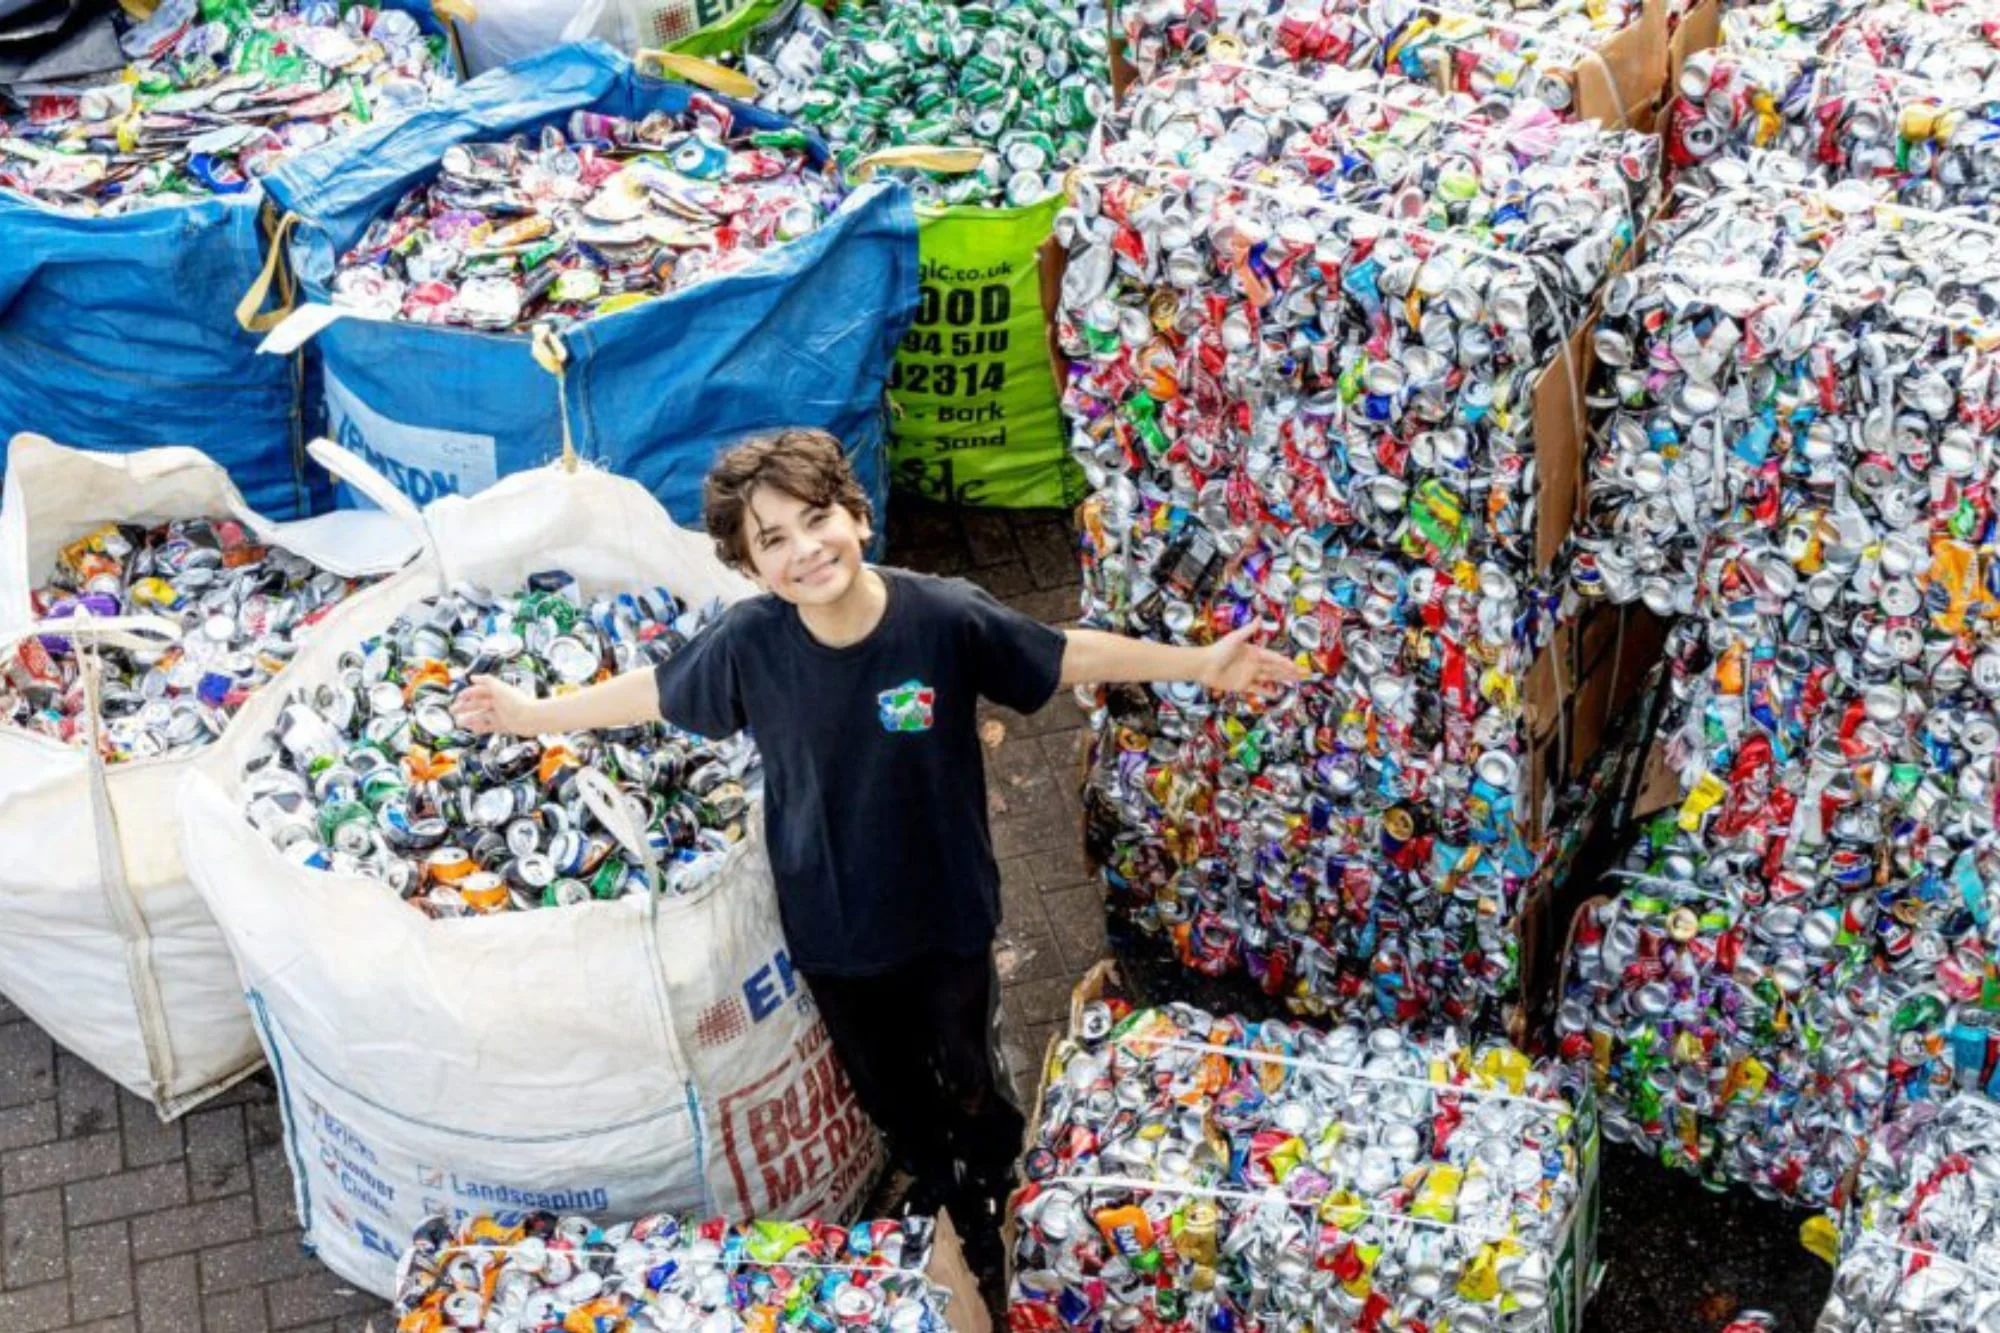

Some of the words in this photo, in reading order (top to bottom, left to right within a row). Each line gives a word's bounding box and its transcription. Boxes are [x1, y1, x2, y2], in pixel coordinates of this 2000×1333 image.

[951, 329, 1009, 356] 5JU
[938, 400, 1005, 423] Bark
[935, 426, 1006, 451] Sand
[450, 1173, 609, 1211] Landscaping
